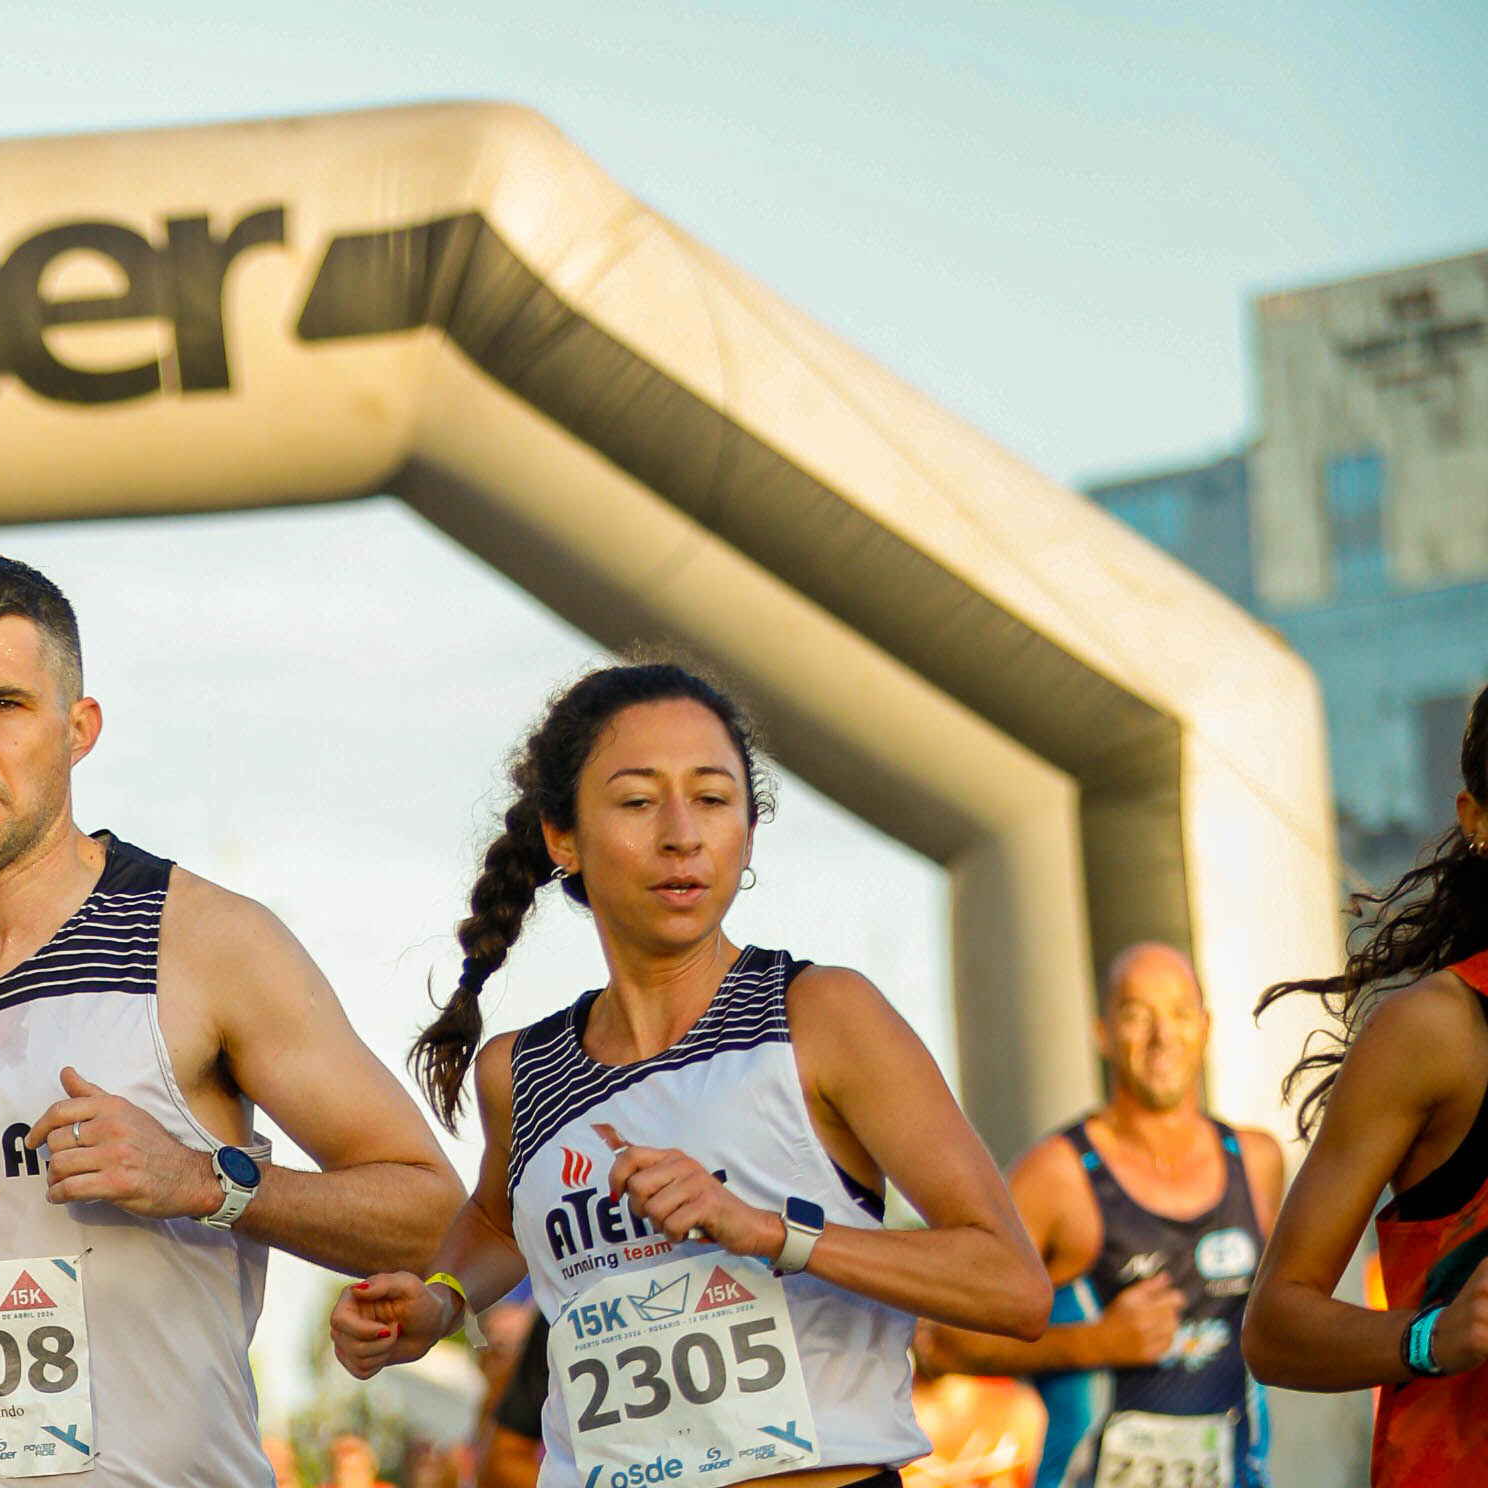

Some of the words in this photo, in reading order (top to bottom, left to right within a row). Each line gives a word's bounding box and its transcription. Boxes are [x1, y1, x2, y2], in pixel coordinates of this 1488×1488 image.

[562, 1252, 619, 1281] running
[624, 1240, 672, 1262] team
[11, 1288, 43, 1306] 15K
[705, 1282, 741, 1304] 15K
[2, 1313, 11, 1321] DE
[14, 1311, 34, 1320] ABRIL
[567, 1296, 628, 1340] 15K
[649, 1320, 681, 1333] ROSARIO
[711, 1309, 733, 1320] ABRIL
[568, 1317, 786, 1433] 2305
[23, 1442, 56, 1452] POWER
